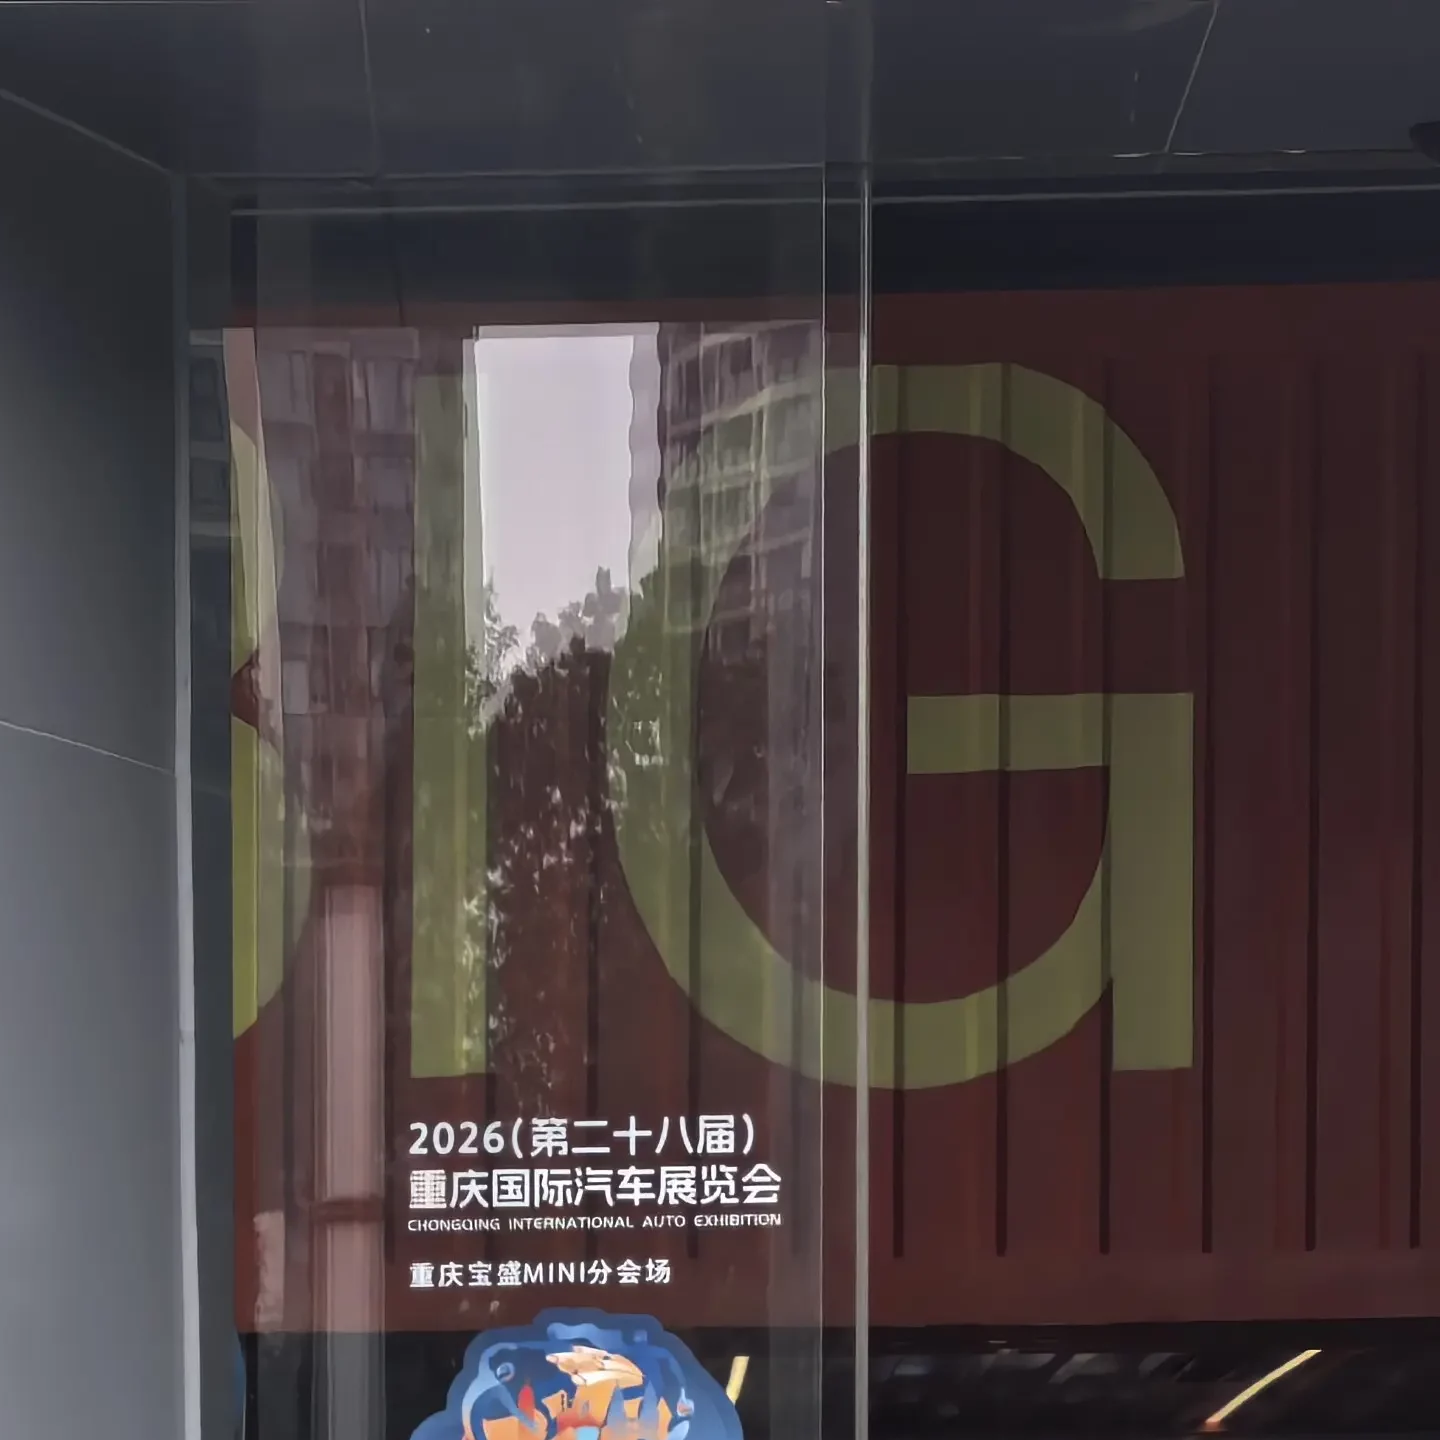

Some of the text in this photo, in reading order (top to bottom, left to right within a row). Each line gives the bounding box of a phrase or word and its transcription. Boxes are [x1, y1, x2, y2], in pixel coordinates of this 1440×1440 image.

[232, 362, 1197, 1090] IG
[409, 1113, 756, 1159] 2026(第二十八届)
[409, 1163, 783, 1210] 重庆国际汽车展览会
[407, 1213, 782, 1232] CHONGQING INTERNATIONAL AUTO EXHIBITION
[409, 1258, 671, 1288] 重庆宝盛MINI分会场
